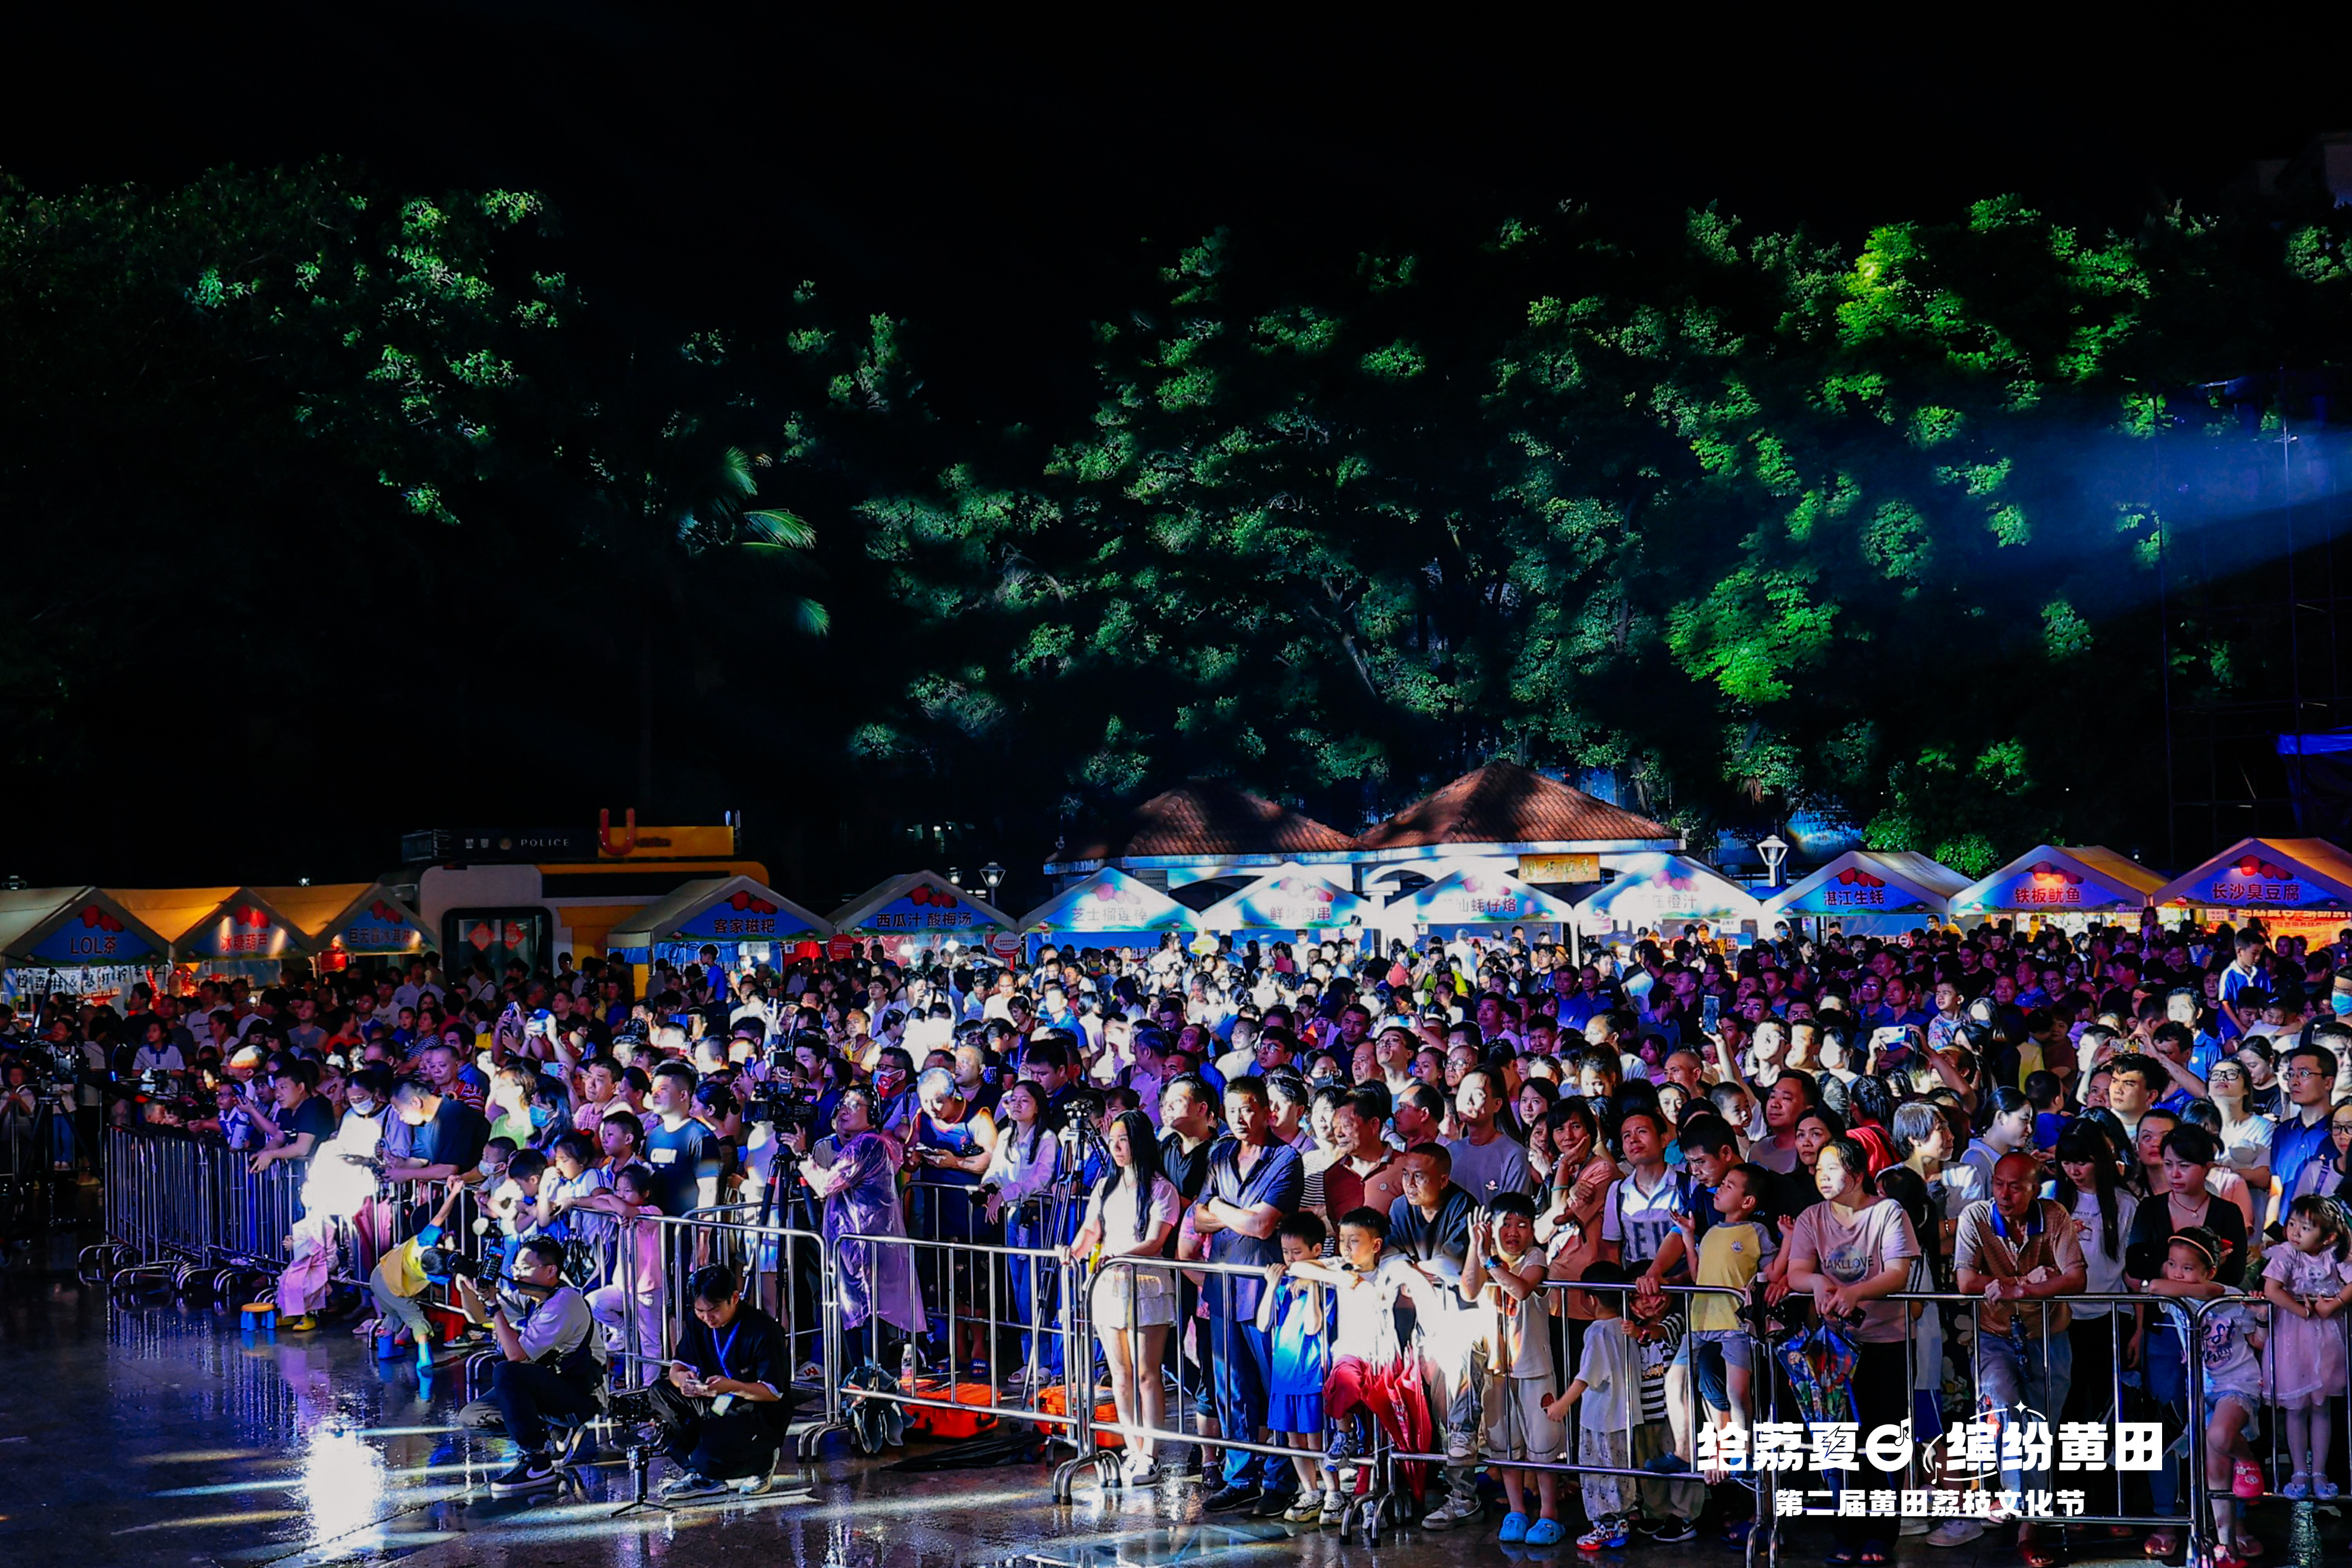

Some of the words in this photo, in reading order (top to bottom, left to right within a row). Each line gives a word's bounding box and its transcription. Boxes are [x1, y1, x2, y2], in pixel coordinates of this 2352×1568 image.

[520, 838, 570, 847] POLICE
[1823, 890, 1885, 905] 湛江生蚝
[2014, 887, 2082, 904] 铁板鱿鱼
[2212, 883, 2300, 901] 长沙臭豆腐
[714, 918, 776, 934] 客家糍粑
[876, 913, 923, 928] 西瓜汁
[927, 912, 972, 927] 酸梅汤
[70, 936, 118, 955] LOL茶
[219, 934, 268, 951] 冰糖葫芦
